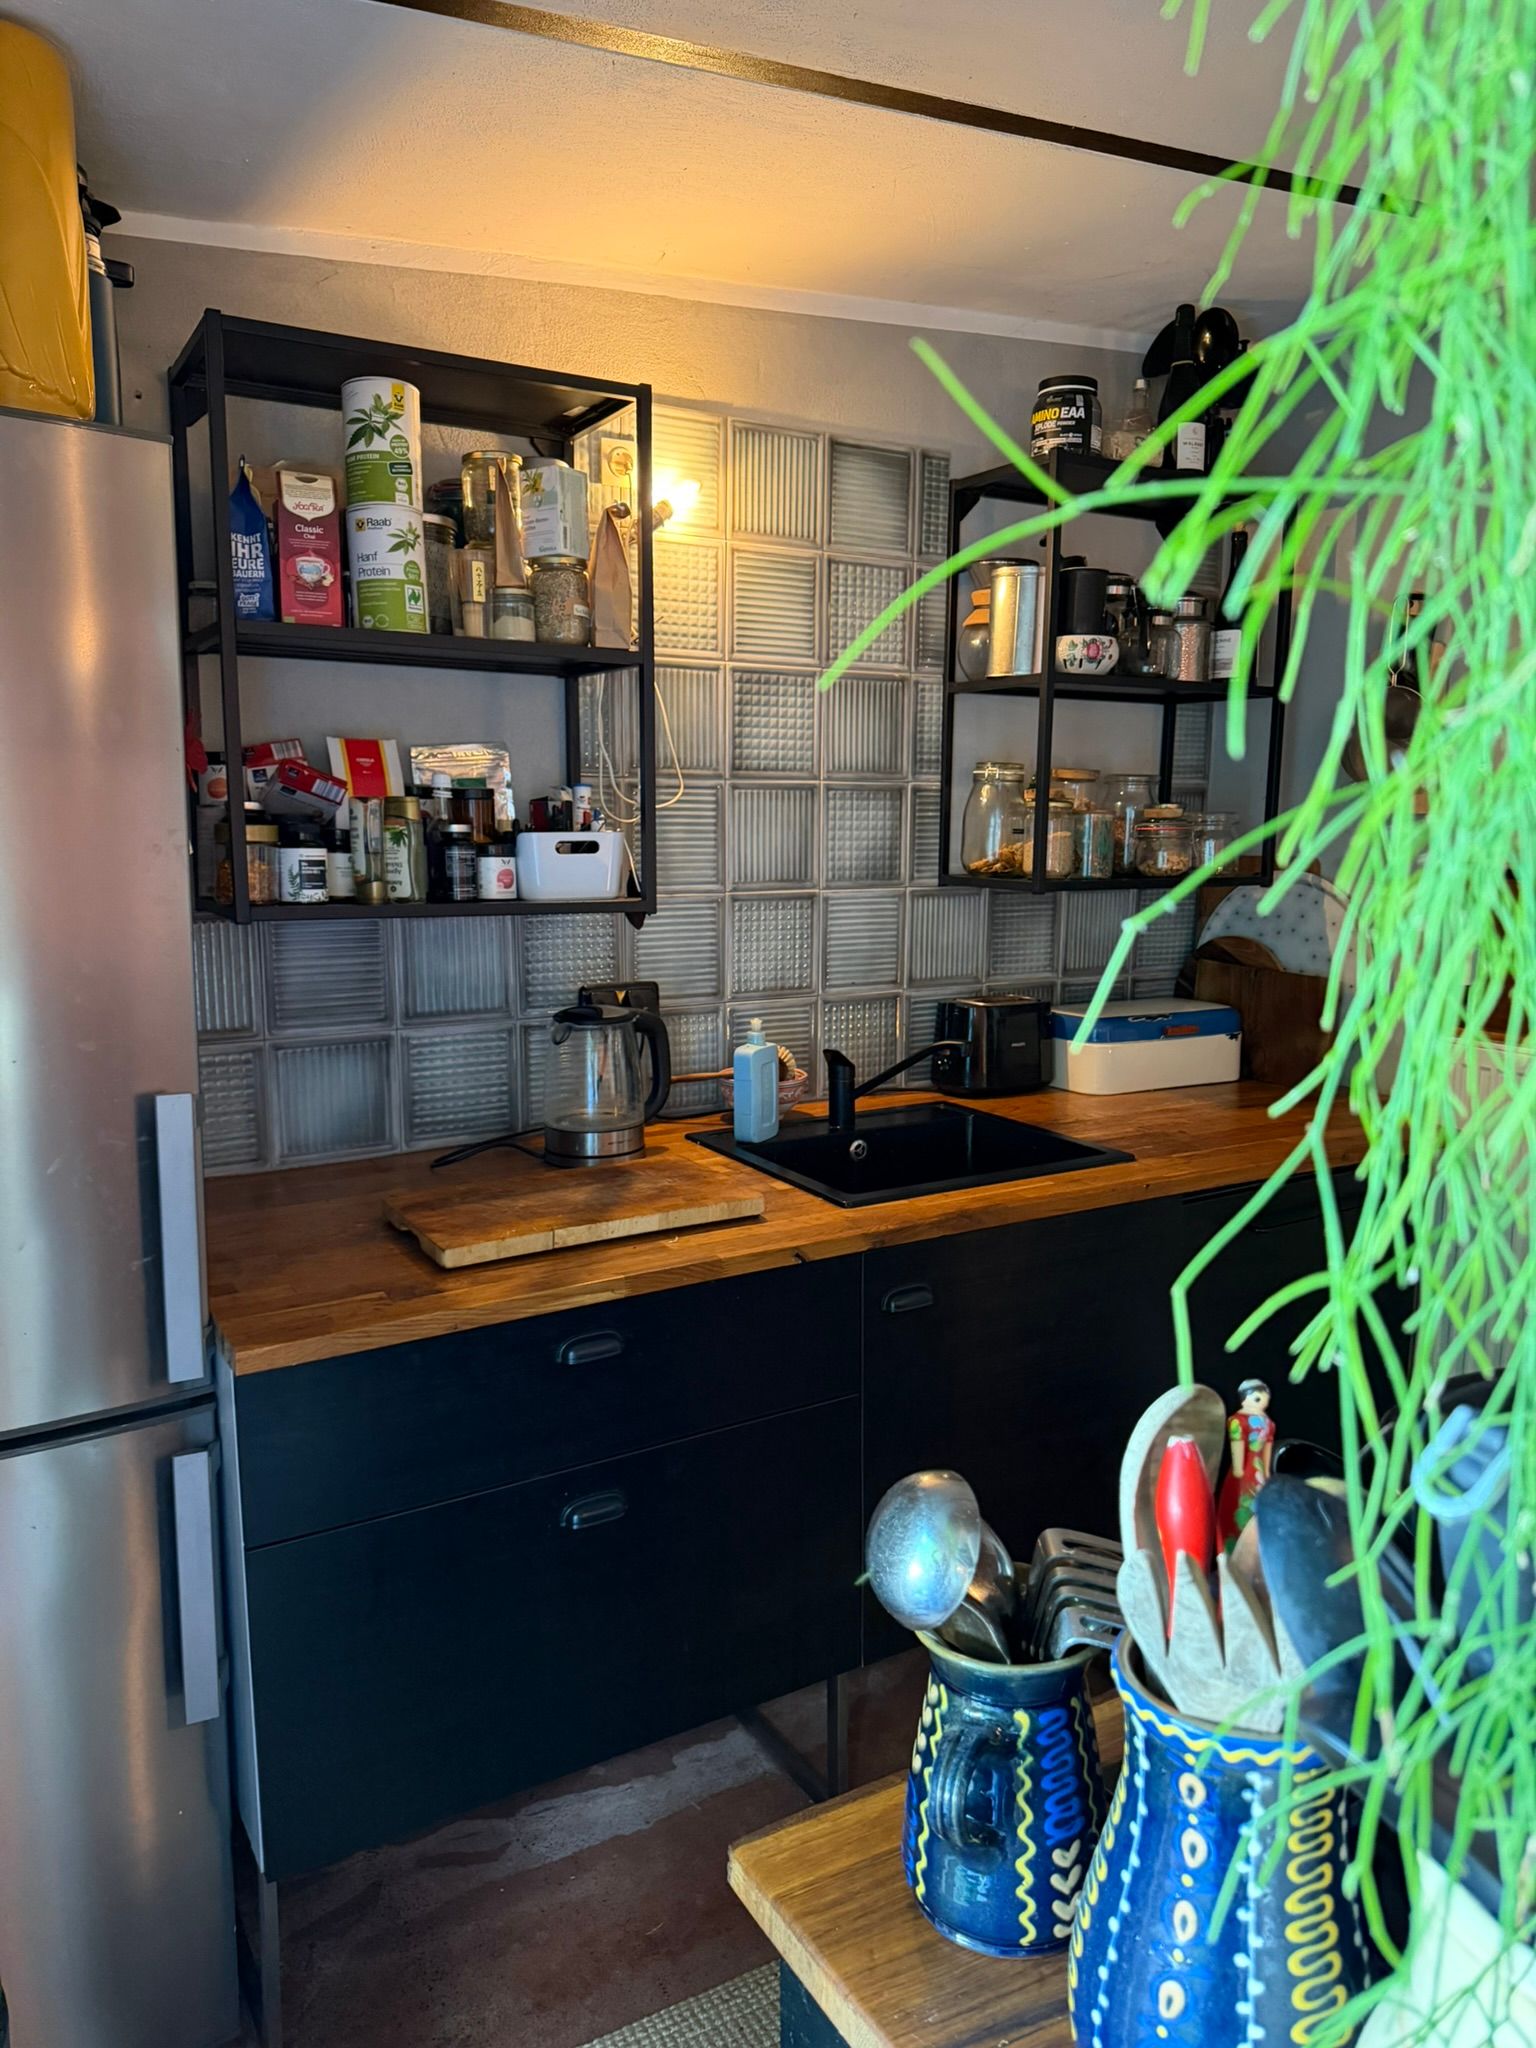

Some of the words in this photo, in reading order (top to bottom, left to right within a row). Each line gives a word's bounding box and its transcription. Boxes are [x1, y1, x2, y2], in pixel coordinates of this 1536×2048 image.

[1031, 408, 1059, 425] AMINO
[1060, 406, 1085, 419] EAA
[366, 517, 392, 527] Raab
[295, 523, 324, 534] Classic
[230, 532, 262, 543] KENNT
[231, 542, 264, 558] IHR
[357, 551, 378, 562] Hanf
[232, 557, 264, 569] EURE
[358, 567, 391, 578] Protein
